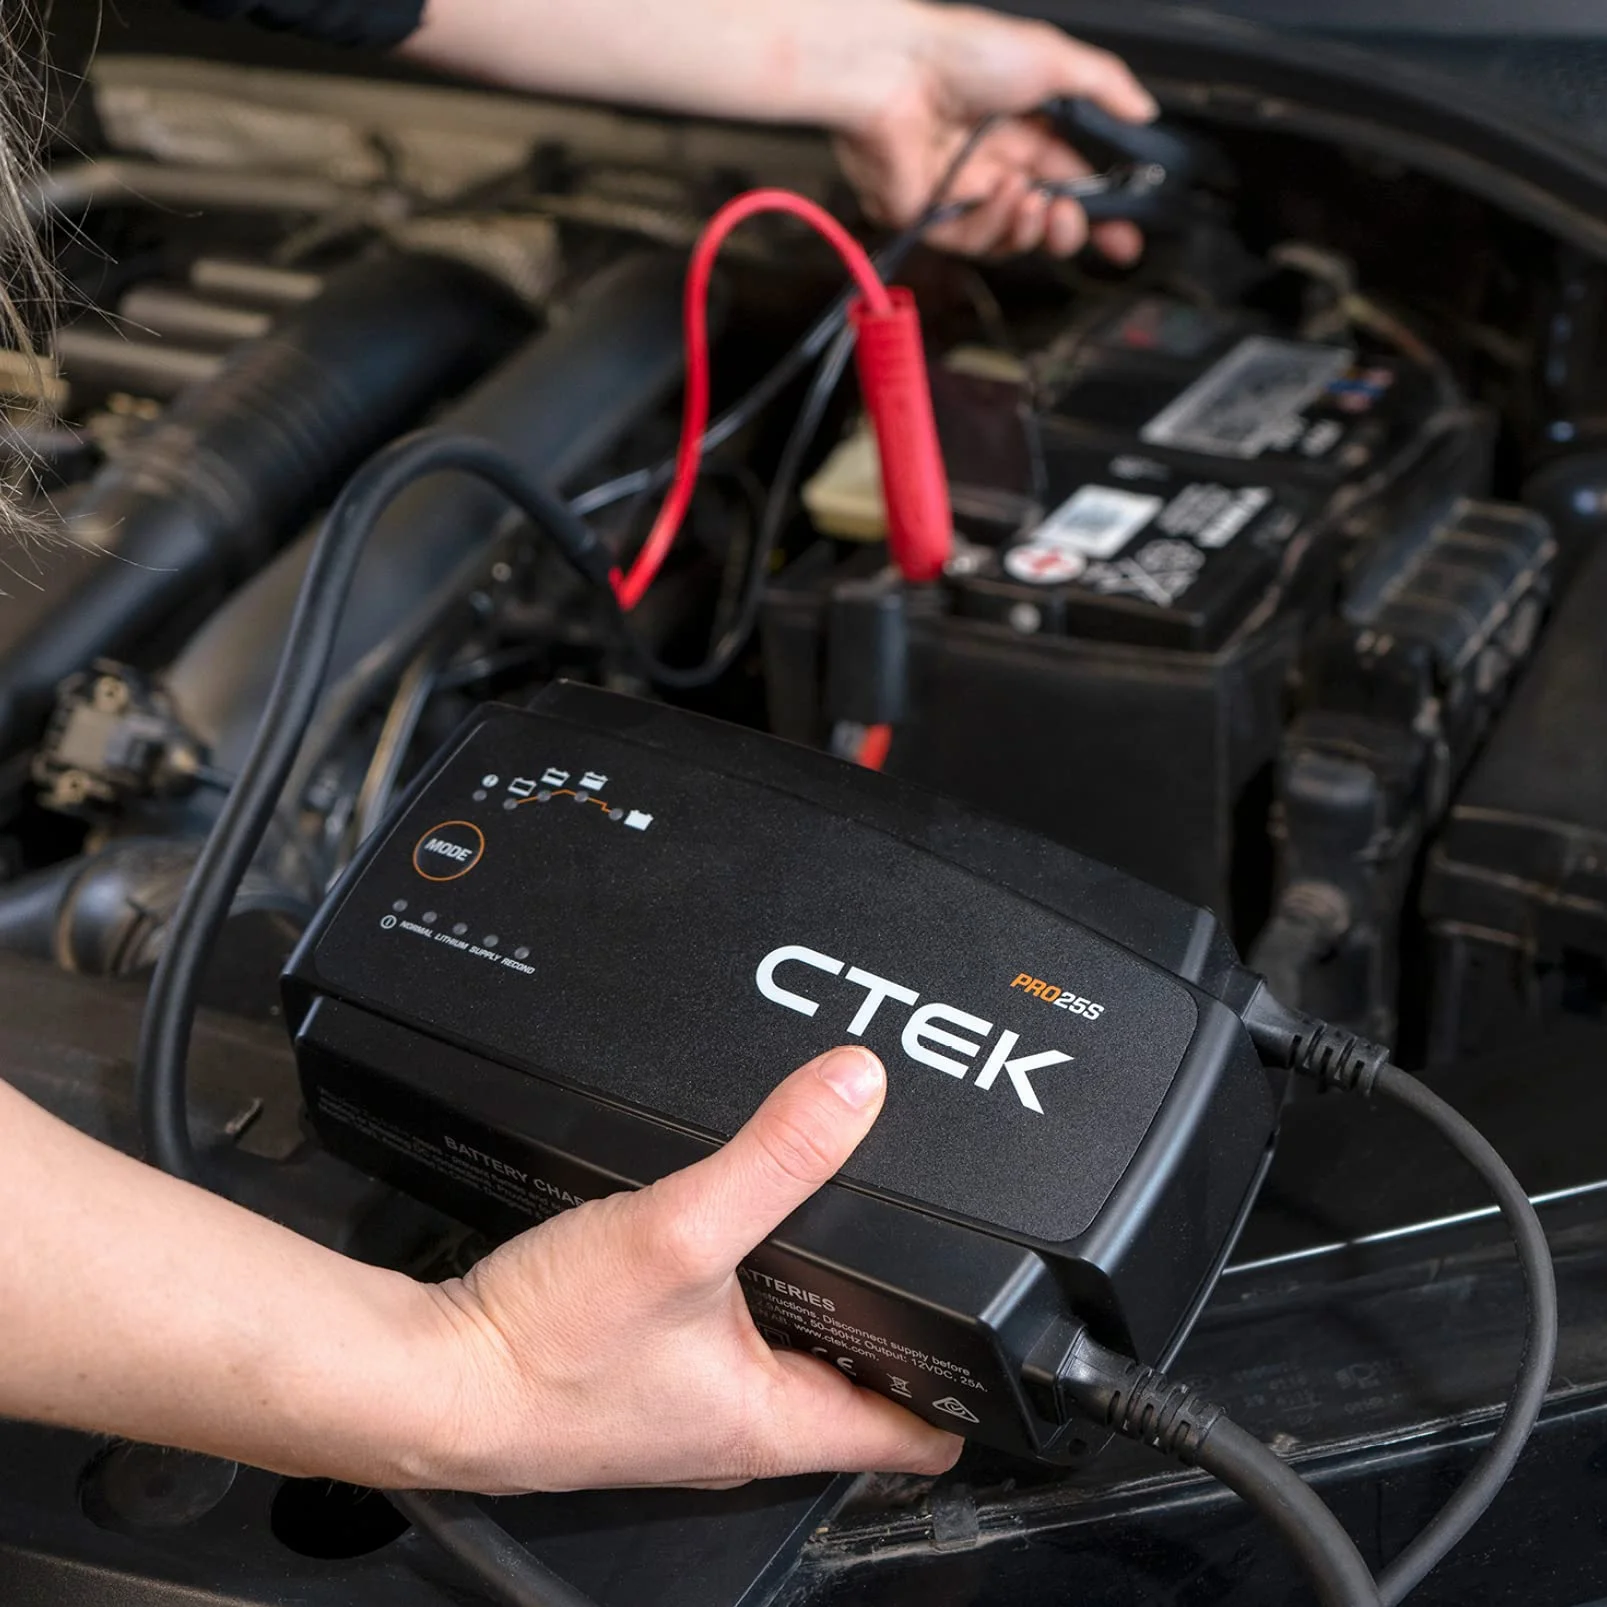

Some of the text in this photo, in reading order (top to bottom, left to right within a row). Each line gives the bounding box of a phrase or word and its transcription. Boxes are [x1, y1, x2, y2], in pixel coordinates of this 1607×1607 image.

[424, 838, 473, 862] MODE
[399, 920, 536, 975] NORMAL LITHIUM SUPPLY RECOND
[1009, 972, 1104, 1021] PRO25S
[755, 944, 1075, 1115] CTEK
[443, 1135, 528, 1185] BATTERY
[822, 1314, 888, 1345] Disconnect
[890, 1341, 929, 1364] supply
[931, 1355, 971, 1377] before
[864, 1340, 908, 1363] Output:
